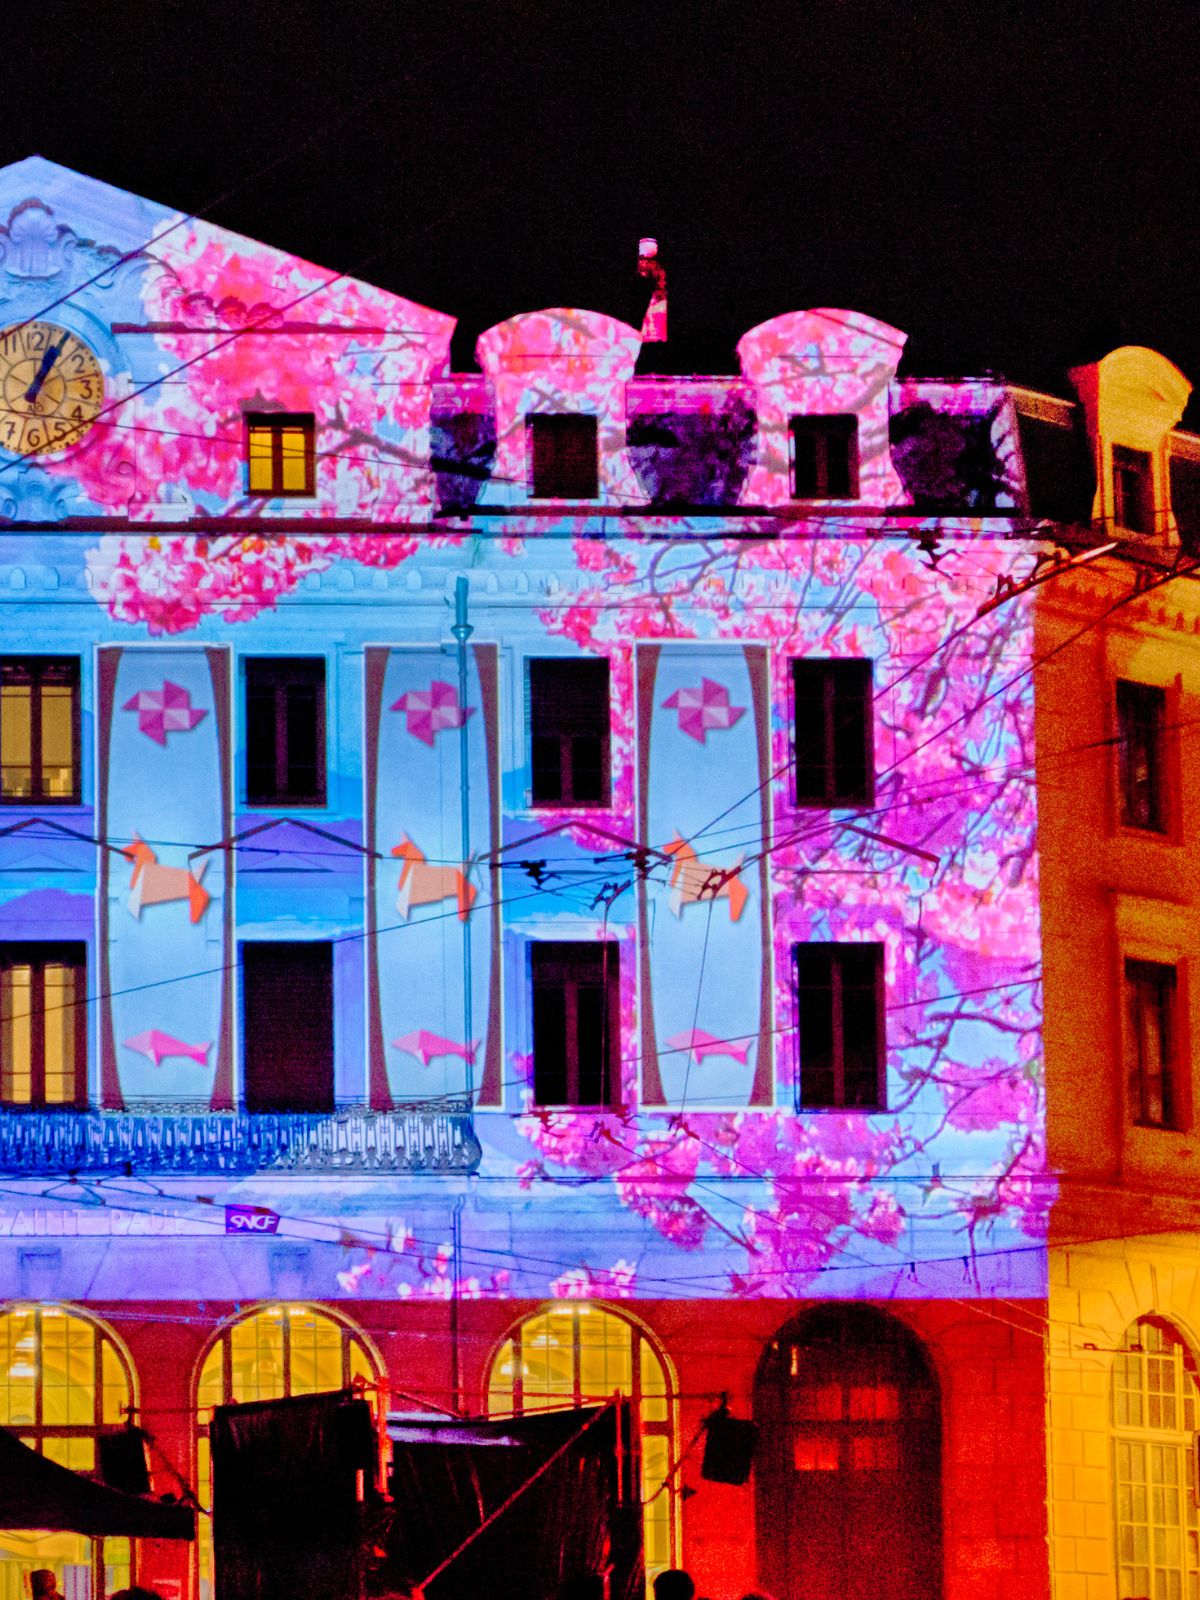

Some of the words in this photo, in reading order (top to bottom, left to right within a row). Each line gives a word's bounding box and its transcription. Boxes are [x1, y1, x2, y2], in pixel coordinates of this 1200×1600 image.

[3, 332, 17, 356] 11
[26, 331, 45, 352] 12
[71, 354, 86, 374] 2
[80, 380, 93, 400] 3
[71, 405, 84, 424] 4
[5, 421, 16, 440] 7
[27, 428, 41, 448] 6
[53, 422, 67, 442] 5
[108, 1209, 184, 1236] PAUL
[229, 1214, 276, 1230] SNCF
